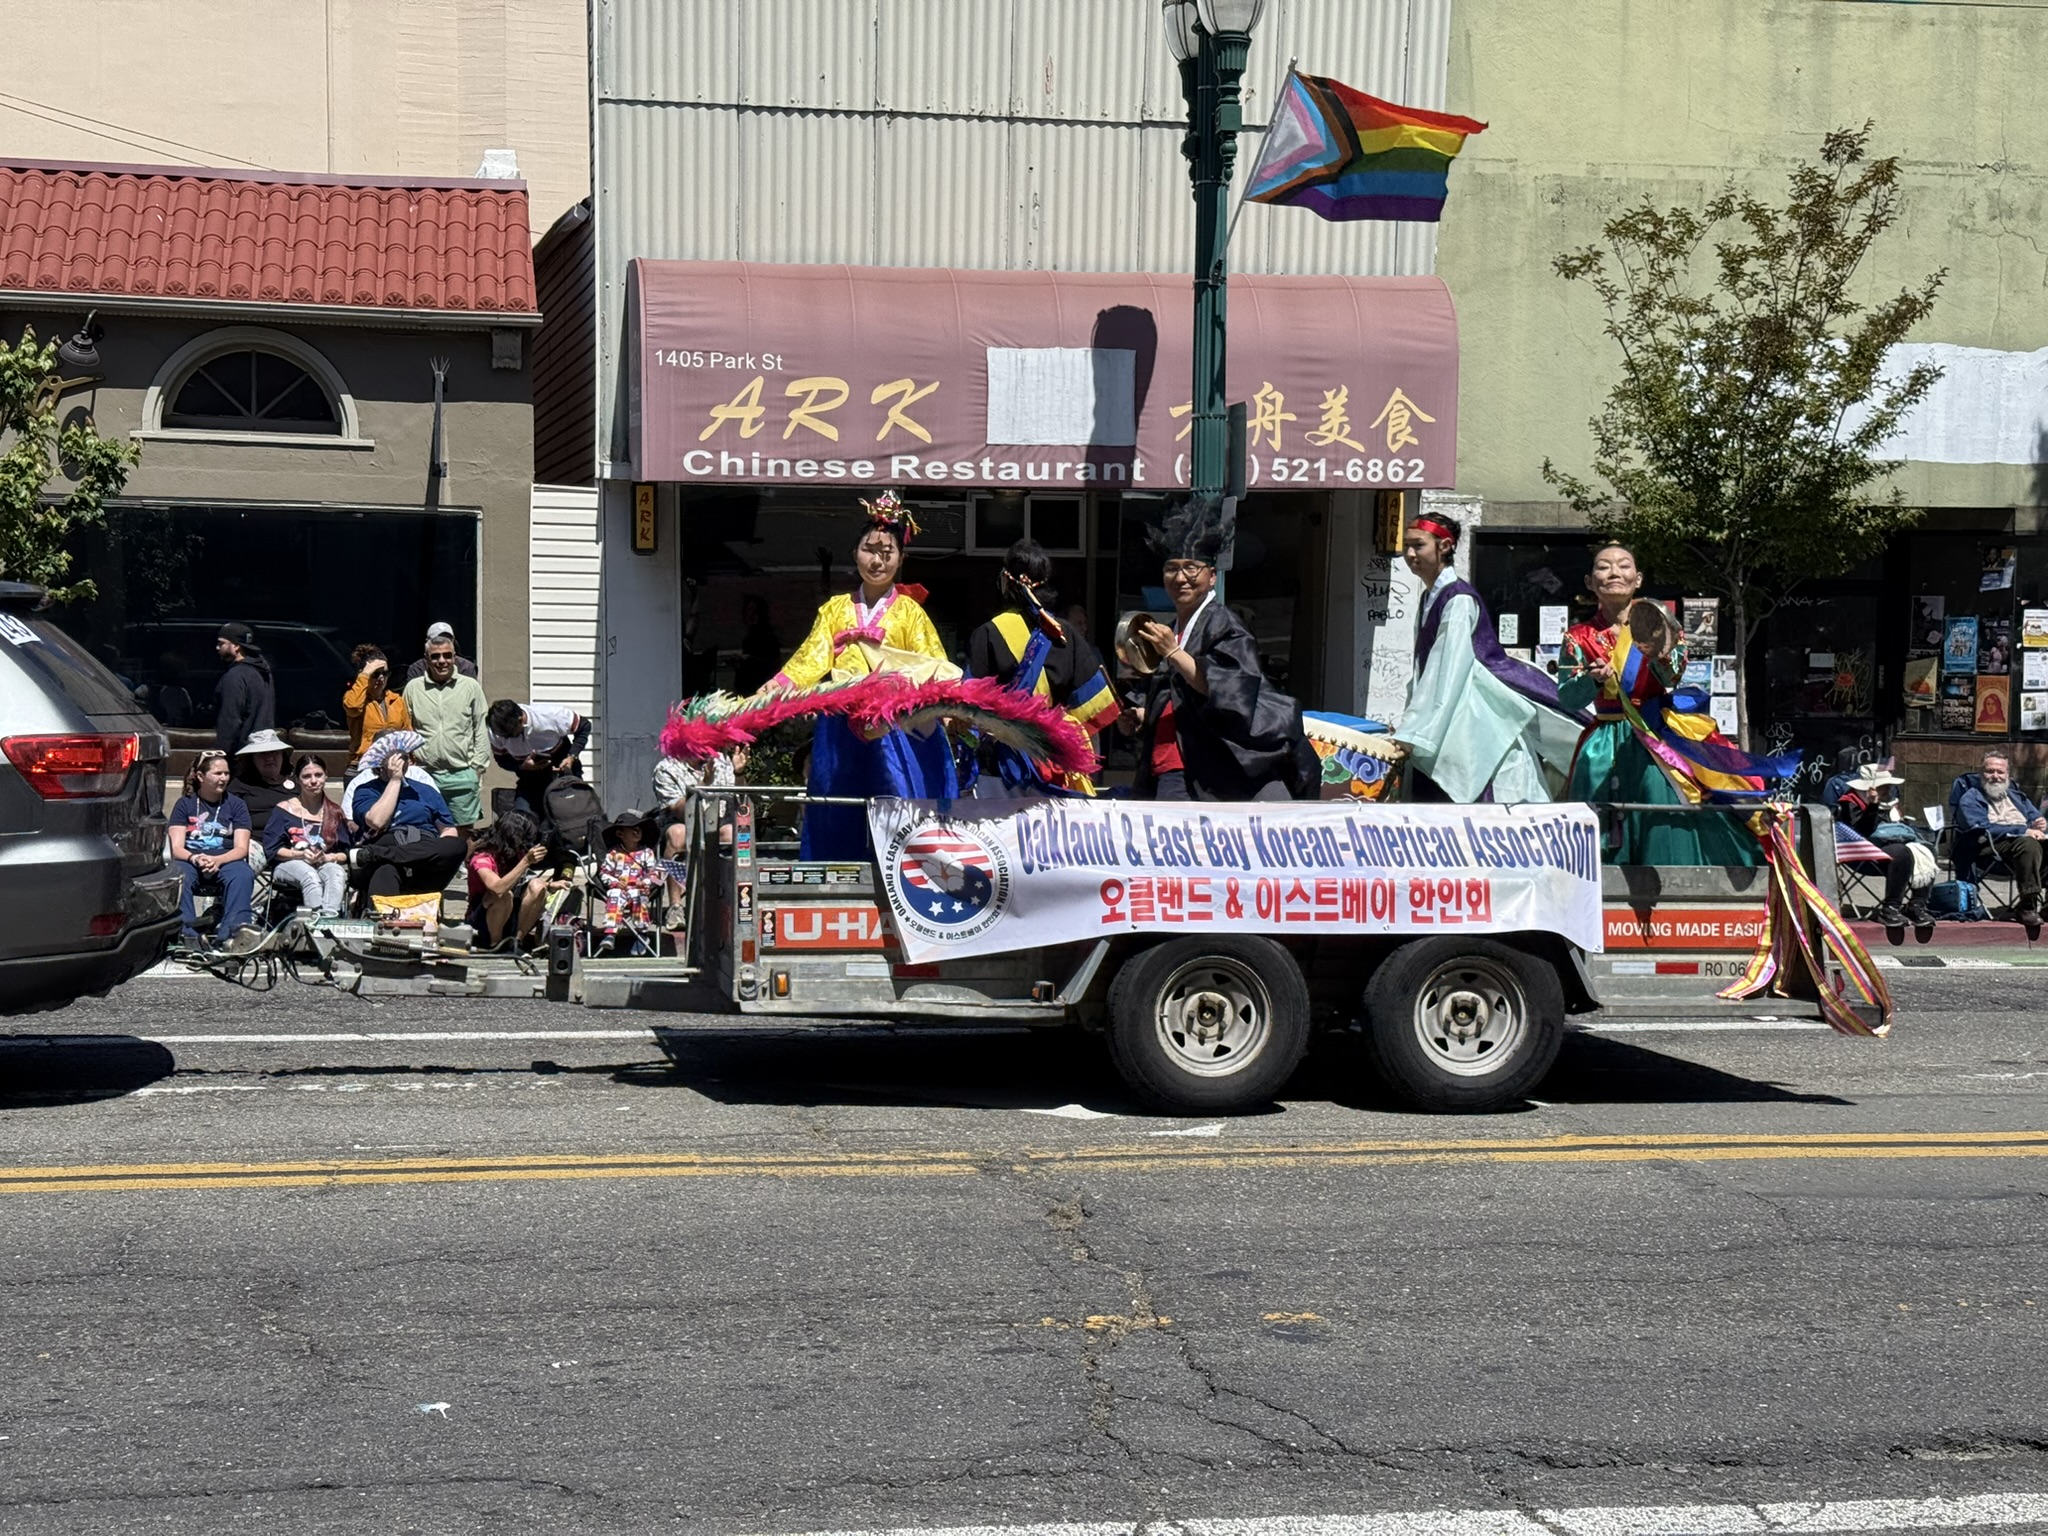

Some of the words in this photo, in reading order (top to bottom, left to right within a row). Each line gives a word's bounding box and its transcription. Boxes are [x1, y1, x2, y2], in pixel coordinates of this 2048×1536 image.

[655, 349, 704, 368] 1405
[710, 352, 756, 369] Park
[761, 353, 783, 371] St
[698, 375, 940, 444] ARK
[682, 450, 875, 480] Chinese
[890, 454, 1146, 481] Restaurant
[1270, 457, 1425, 483] 521-6862
[639, 491, 652, 542] ARK
[1016, 808, 1121, 874] Oakland
[1120, 813, 1145, 867] &
[1142, 814, 1203, 868] East
[1199, 815, 1252, 871] Bay
[1248, 815, 1469, 868] Korean-American
[1462, 813, 1598, 882] Association
[885, 873, 907, 917] OAKLAND
[990, 845, 1009, 905] ASSOCIATION
[1100, 876, 1213, 924] 오클랜드
[1224, 876, 1244, 920] &
[1255, 876, 1396, 924] 이스트베이
[1408, 877, 1493, 924] 한인회
[783, 911, 898, 941] U-HA
[1607, 921, 1672, 937] MOVING
[1675, 922, 1721, 937] MADE
[1724, 921, 1763, 937] EASI
[1728, 962, 1747, 977] 06
